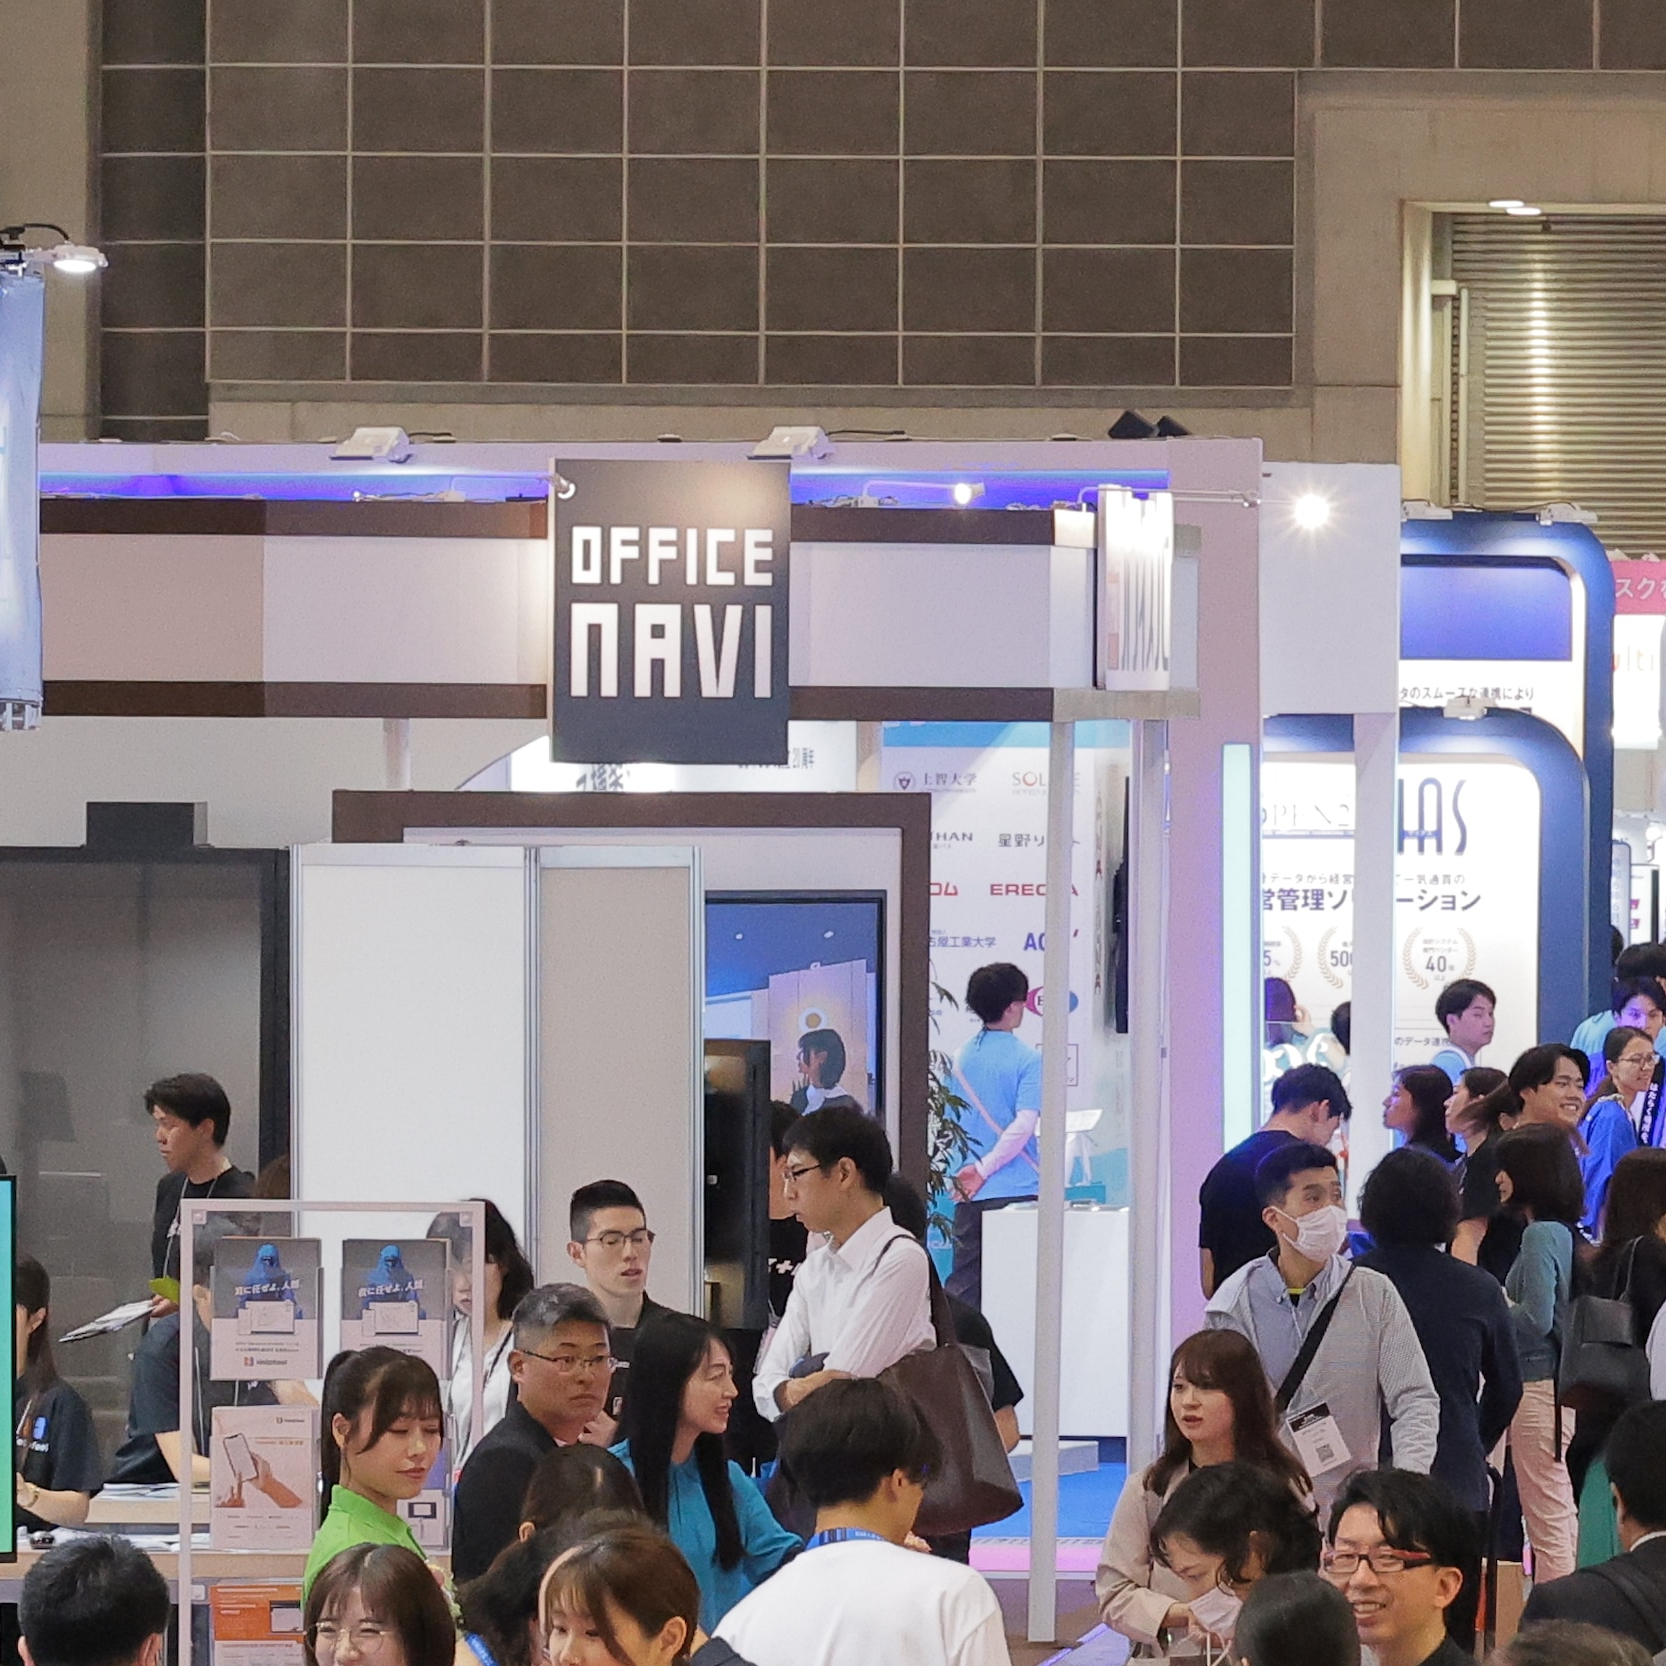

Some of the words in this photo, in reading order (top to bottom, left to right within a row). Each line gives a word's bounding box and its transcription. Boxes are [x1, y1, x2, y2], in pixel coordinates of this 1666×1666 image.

[571, 526, 774, 586] OFFICE
[569, 602, 773, 698] NAVI
[1012, 772, 1080, 787] SOLE
[931, 832, 973, 842] HAN
[1425, 955, 1447, 972] 40
